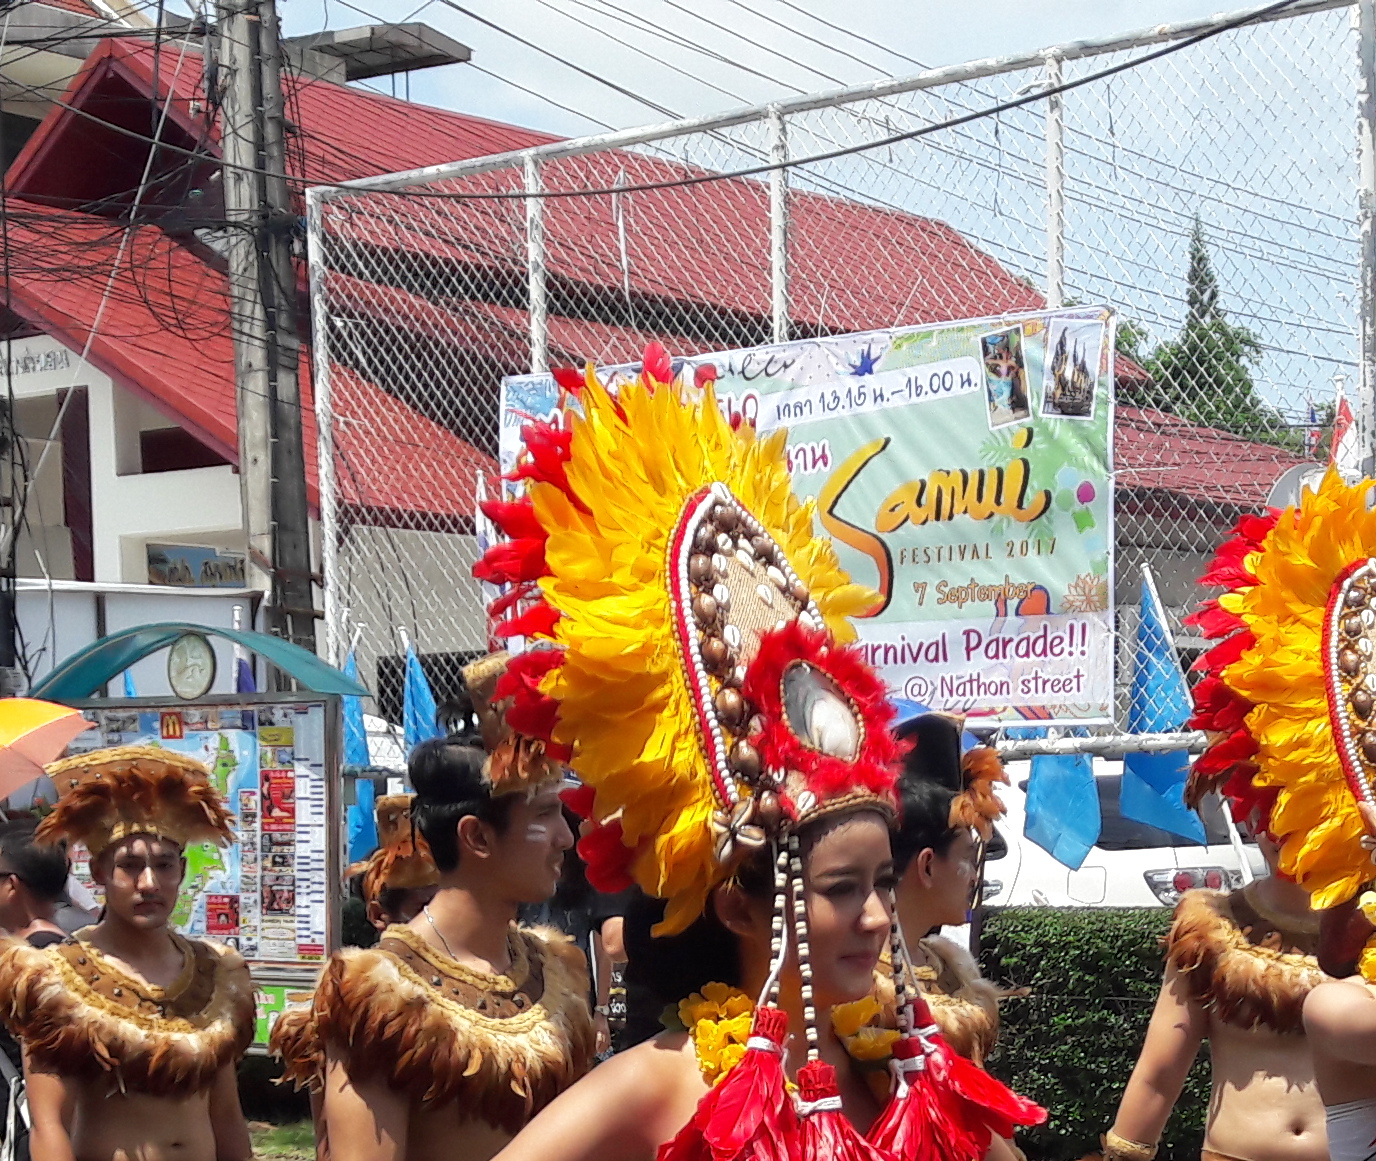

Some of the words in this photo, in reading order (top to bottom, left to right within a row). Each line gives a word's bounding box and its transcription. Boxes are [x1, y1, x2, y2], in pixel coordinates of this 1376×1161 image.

[819, 427, 1052, 618] Samui
[899, 542, 993, 566] FESTIVAL
[1006, 537, 1057, 559] 2017
[913, 581, 928, 607] 7
[935, 574, 1038, 609] September
[862, 631, 949, 666] rnival
[962, 621, 1087, 661] Parade!!
[940, 671, 1011, 698] Nathon
[1020, 667, 1085, 695] street
